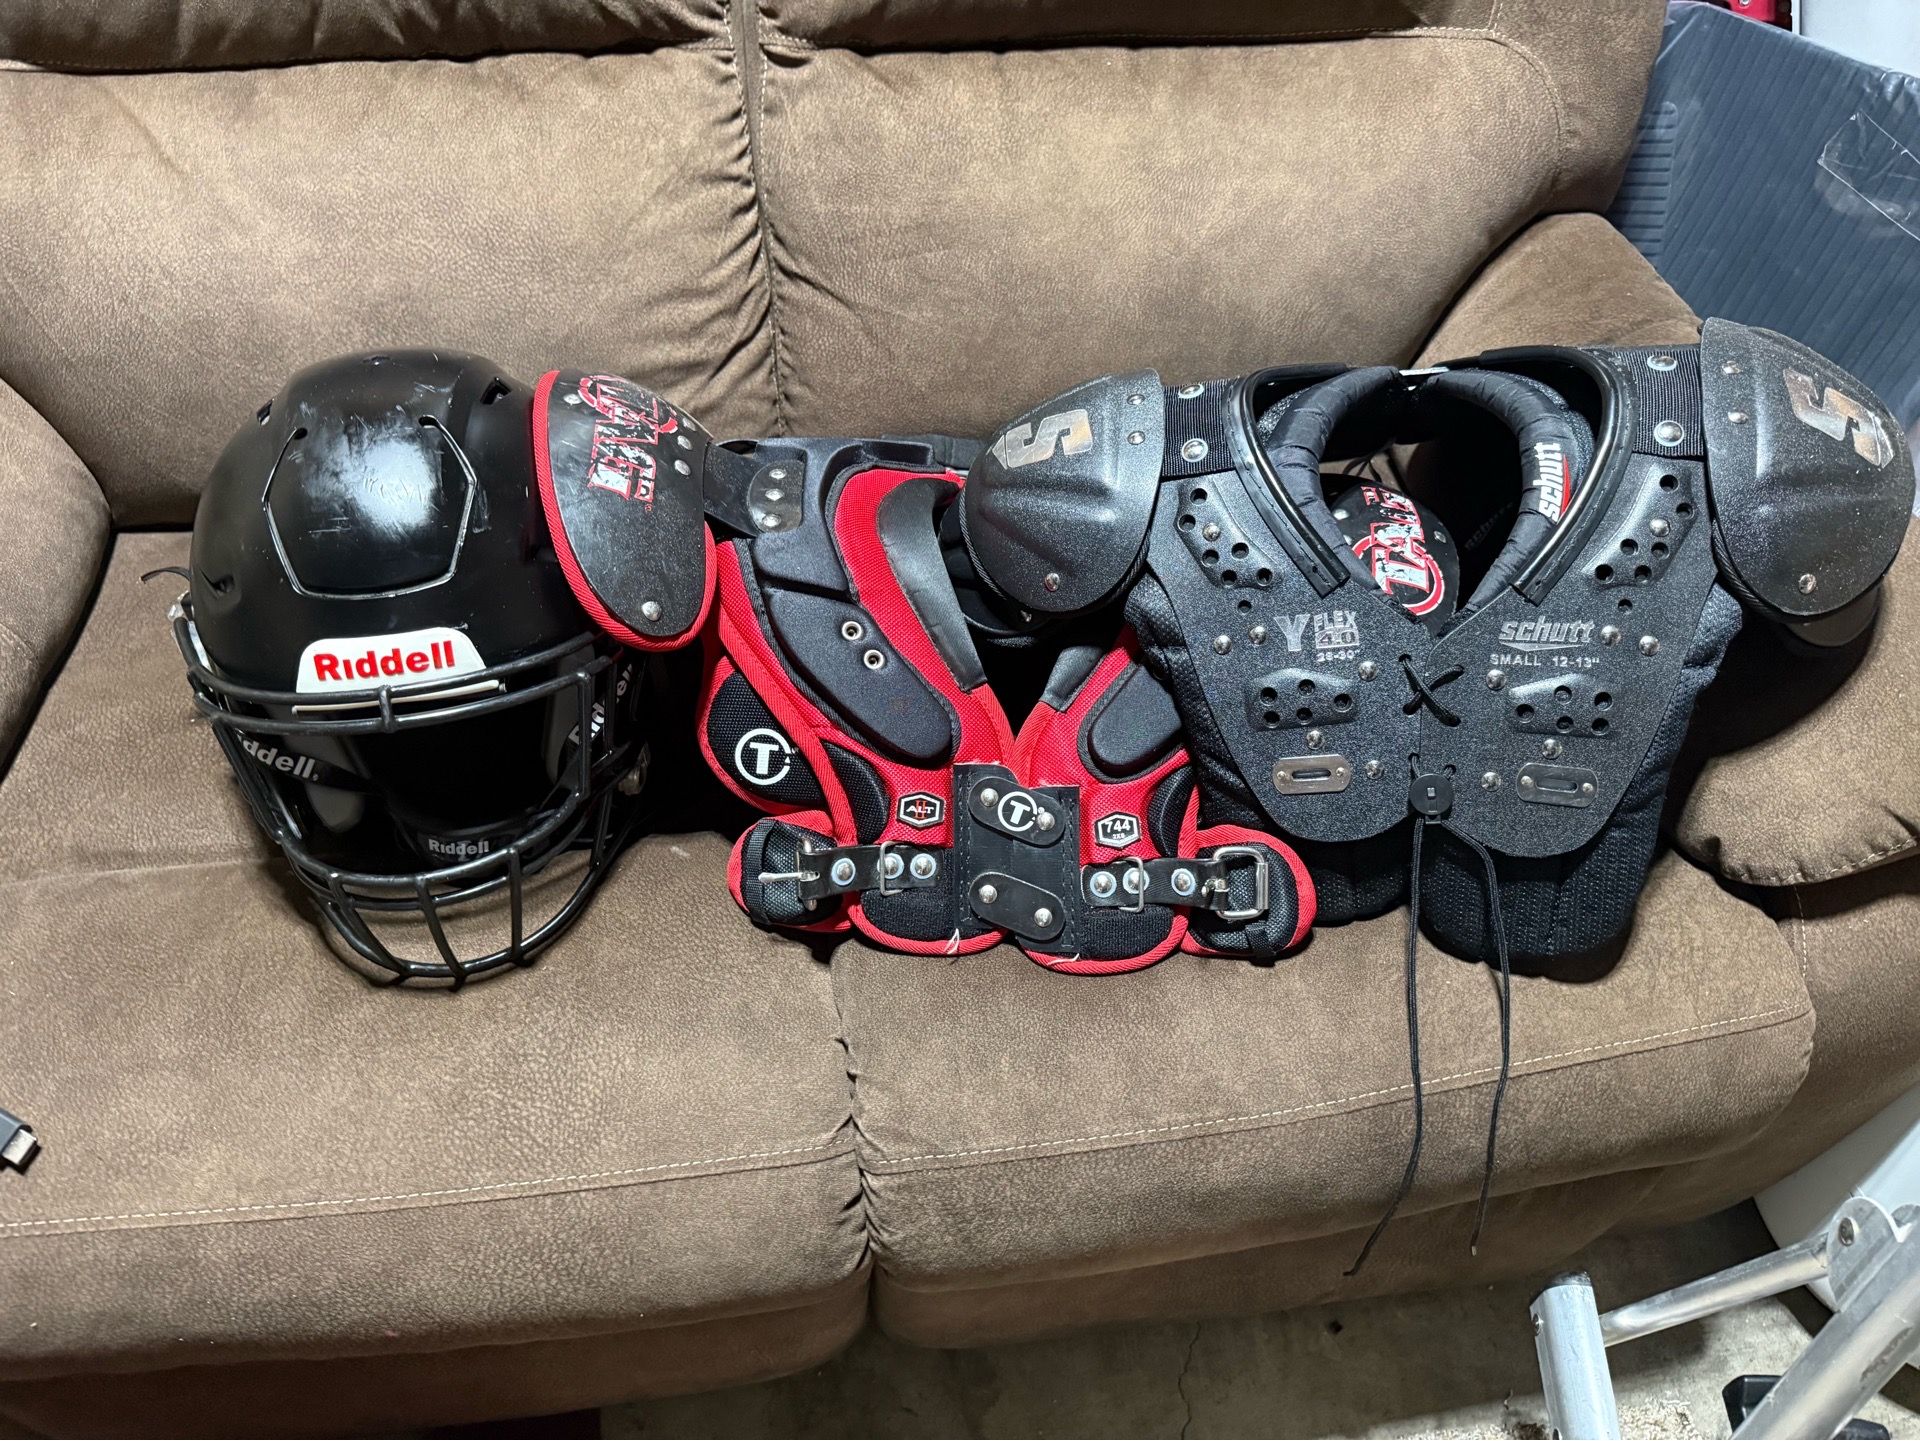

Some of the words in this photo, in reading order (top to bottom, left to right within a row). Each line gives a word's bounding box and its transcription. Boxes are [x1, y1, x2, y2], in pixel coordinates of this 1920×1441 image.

[1533, 442, 1563, 523] schutt
[1273, 613, 1311, 652] Y
[1313, 610, 1358, 632] FLEX
[1318, 629, 1358, 646] 4.0
[1499, 615, 1595, 643] schutt
[313, 640, 455, 681] Riddell
[1489, 653, 1542, 666] SMALL
[1553, 655, 1600, 668] 12-13"
[905, 805, 935, 814] ALT
[1104, 819, 1131, 833] 744
[428, 839, 489, 855] Riddell
